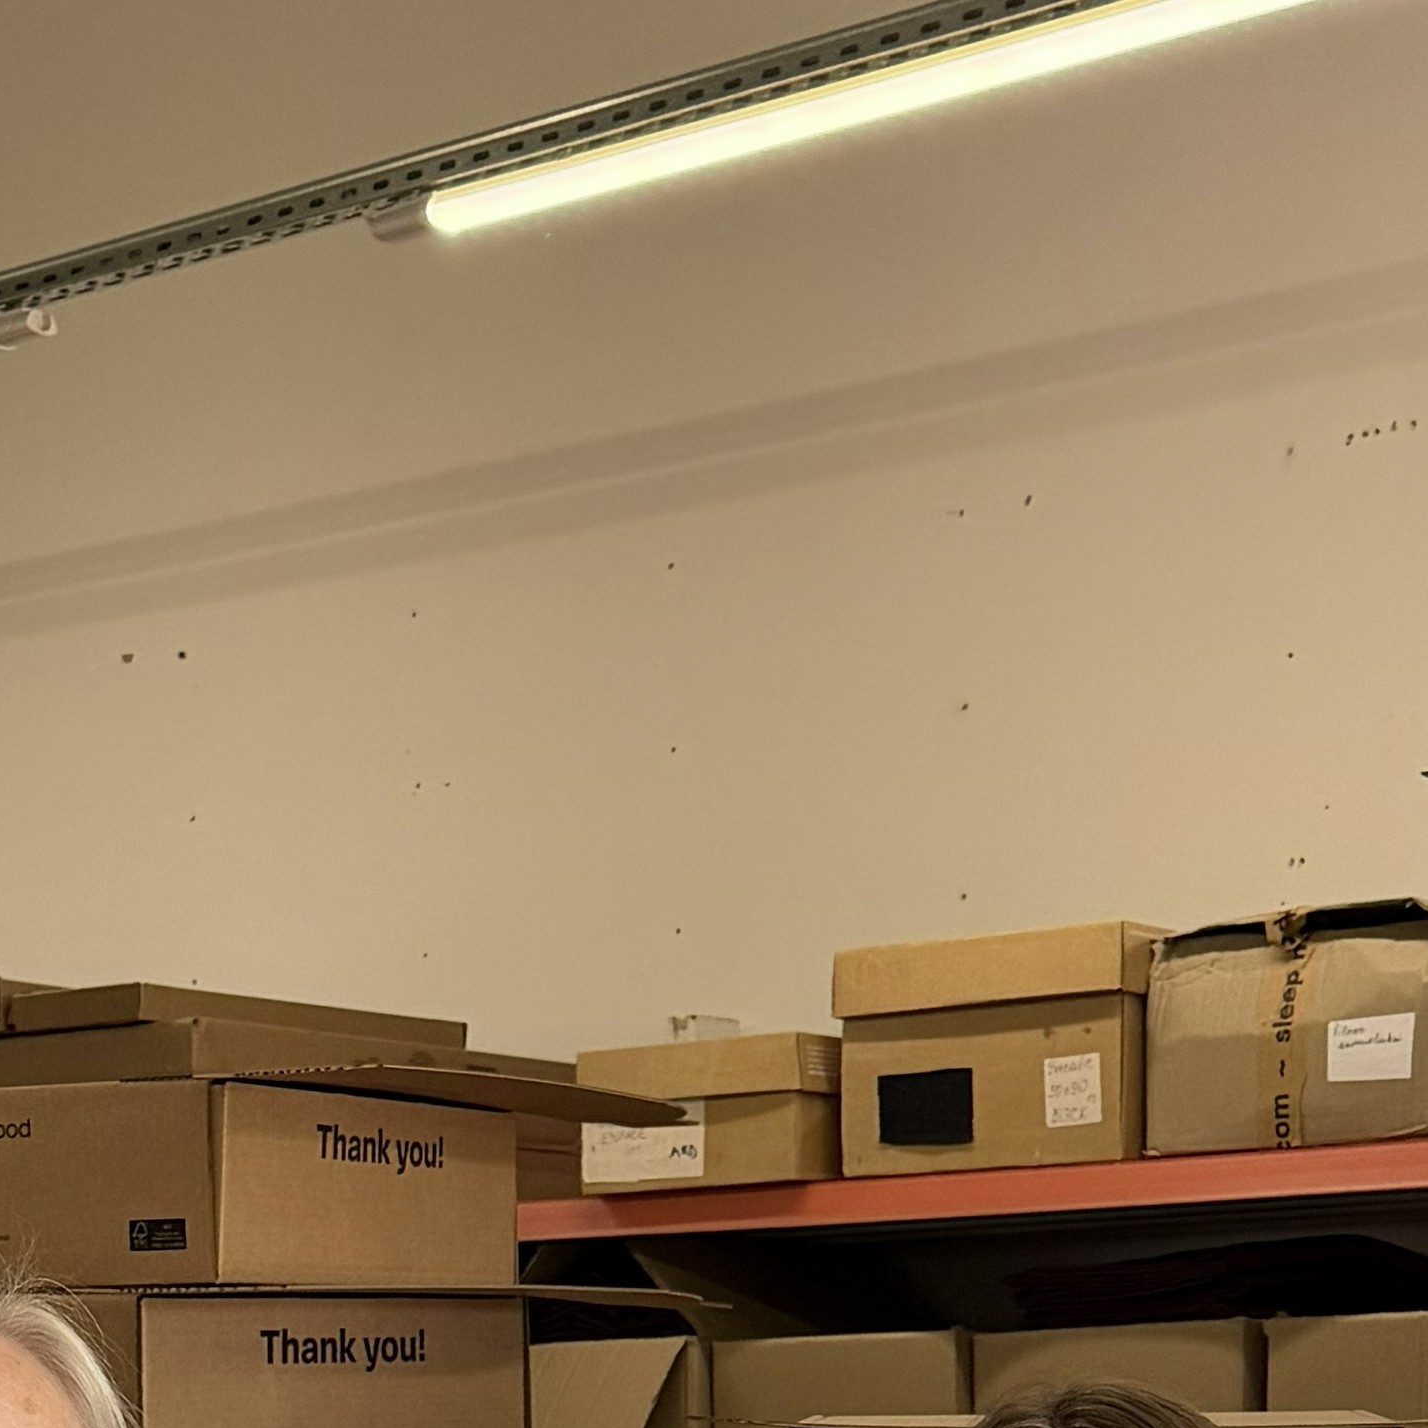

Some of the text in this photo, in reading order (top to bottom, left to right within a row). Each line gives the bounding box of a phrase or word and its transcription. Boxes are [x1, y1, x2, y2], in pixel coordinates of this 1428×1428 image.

[1272, 970, 1303, 1042] sleep
[316, 1124, 445, 1175] Thank you!
[259, 1327, 427, 1373] Thank you!
